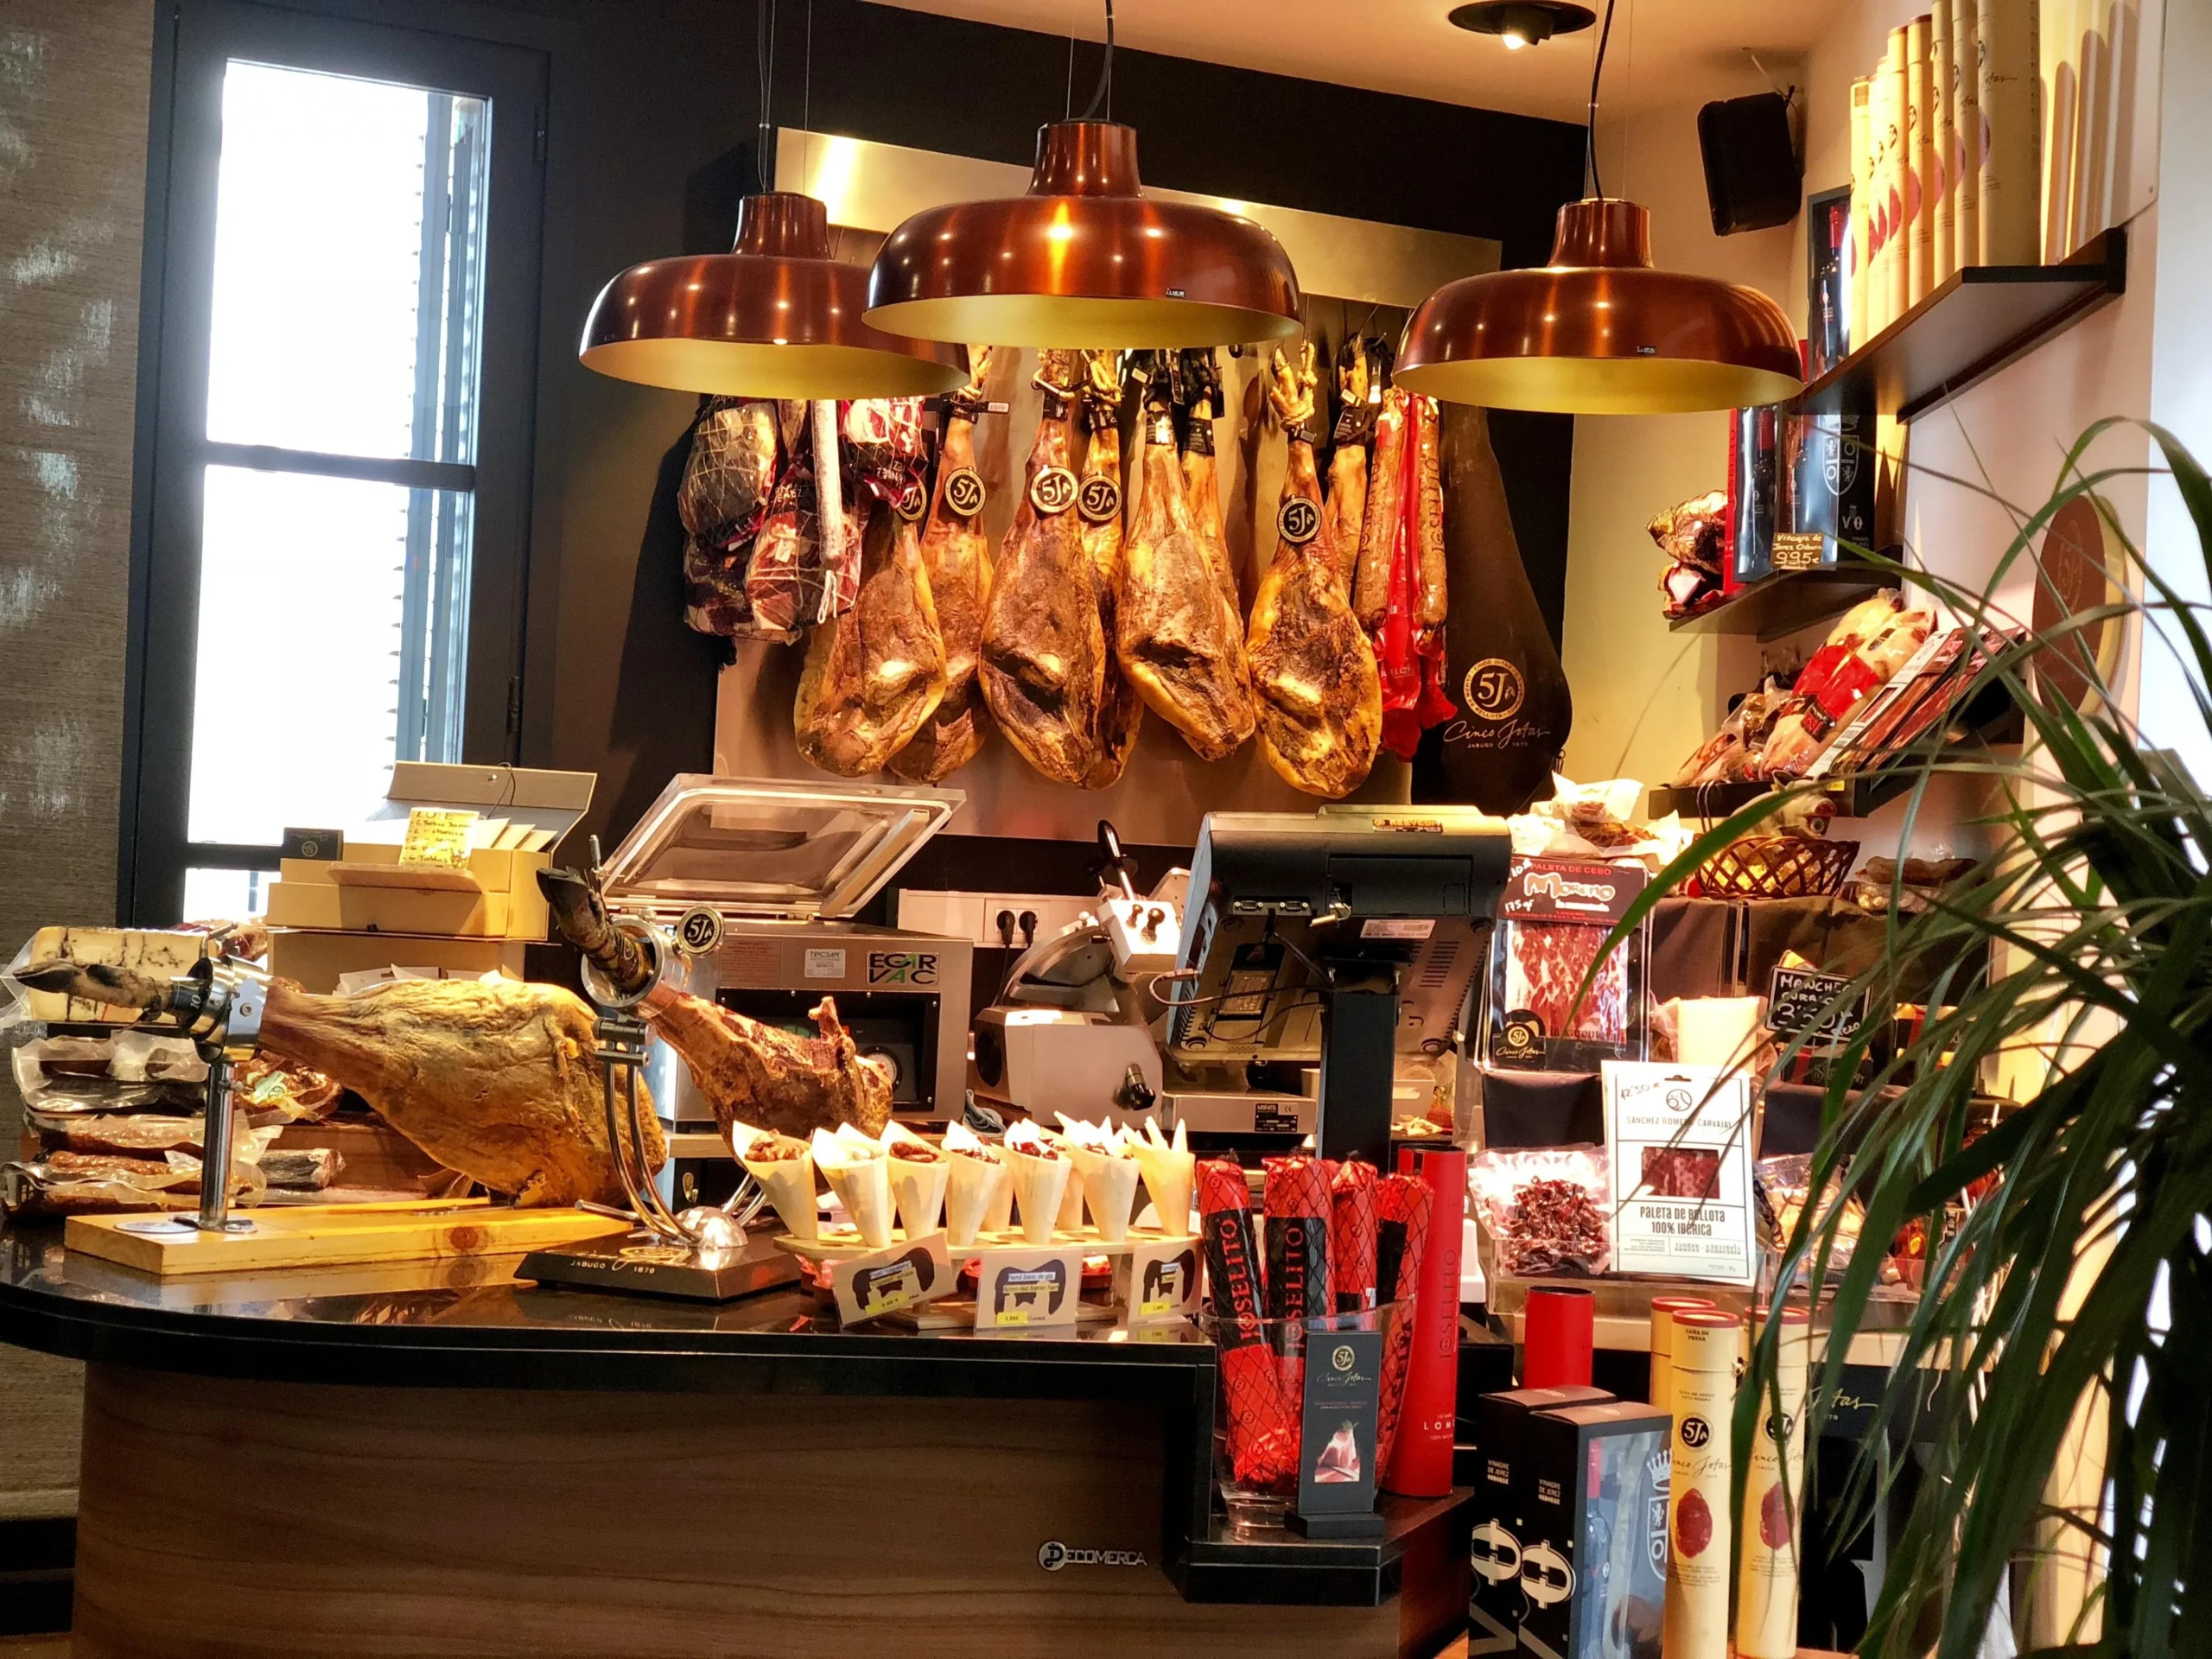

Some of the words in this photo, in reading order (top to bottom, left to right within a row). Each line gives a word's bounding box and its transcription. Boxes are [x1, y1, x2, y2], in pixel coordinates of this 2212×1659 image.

[954, 478, 977, 505] 5J
[1042, 475, 1061, 505] 5J
[1086, 486, 1111, 512] 5J
[1288, 505, 1307, 535] 5J
[1777, 534, 1809, 543] Vinagre
[1478, 672, 1510, 708] 5J
[1443, 720, 1495, 742] Cinco
[1497, 718, 1551, 750] Jotas
[1530, 863, 1567, 873] PALETA
[1584, 867, 1612, 875] CEBO
[688, 918, 709, 944] 5J
[1651, 1221, 1675, 1235] 100%
[569, 1260, 607, 1269] JABUGO
[1219, 1217, 1262, 1340] JOSELITO
[1439, 1249, 1457, 1359] JOSELITO
[1423, 1421, 1455, 1431] LOM
[1684, 1421, 1705, 1445] 5J
[1487, 1459, 1510, 1470] VINAGRE
[1495, 1468, 1510, 1478] JEREZ
[1538, 1485, 1545, 1494] DE
[1546, 1488, 1561, 1498] JEREZ
[1539, 1478, 1561, 1491] VINAGRE
